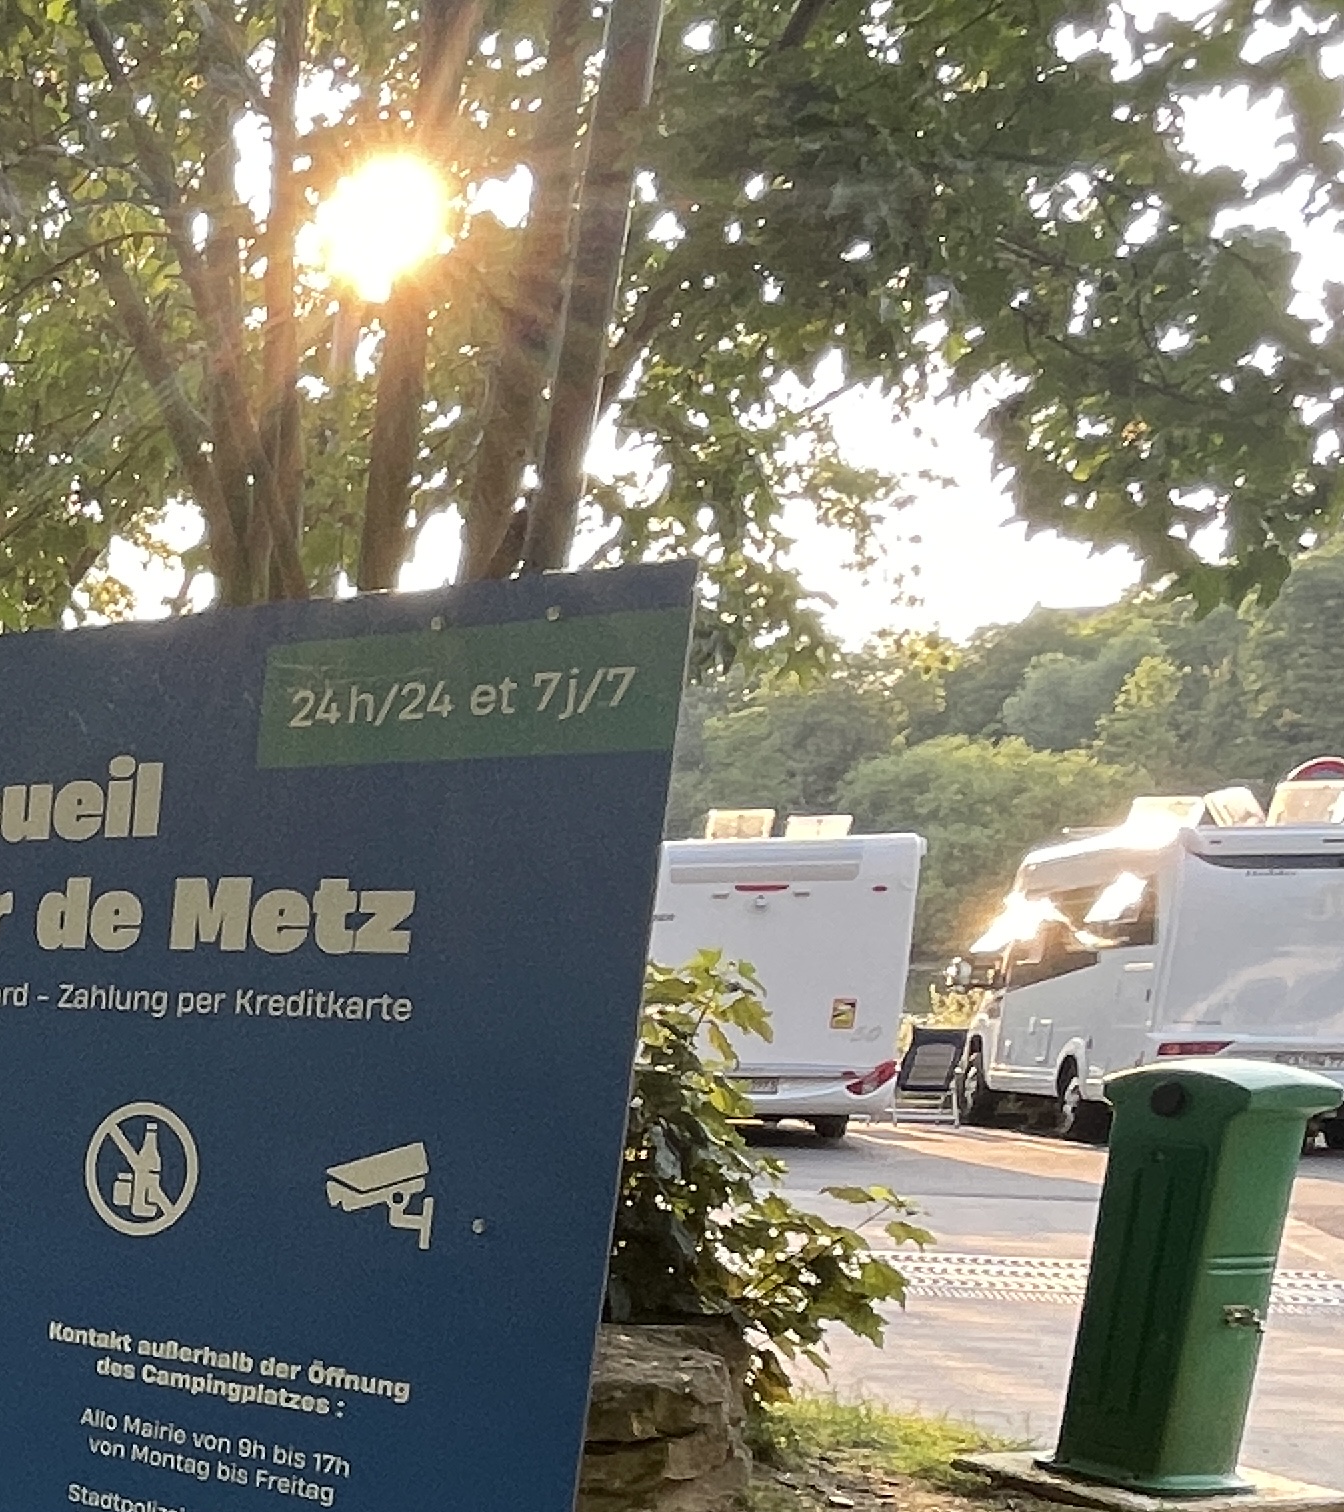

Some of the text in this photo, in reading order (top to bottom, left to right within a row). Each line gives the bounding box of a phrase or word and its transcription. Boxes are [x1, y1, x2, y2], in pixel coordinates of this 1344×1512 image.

[470, 676, 517, 716] et
[533, 667, 636, 720] 7j/7
[36, 876, 144, 951] de
[169, 876, 415, 955] Metz
[56, 984, 168, 1018] Zahlung
[176, 990, 226, 1018] per
[235, 988, 413, 1022] Kreditkarte
[48, 1320, 411, 1404] Kontakt außerhalb der Öffnung
[95, 1355, 136, 1381] des
[141, 1363, 330, 1415] Campingplatzes
[80, 1407, 351, 1478] Allo Mairie von 9h bis 17h
[88, 1435, 335, 1507] von Montag bis Freitag
